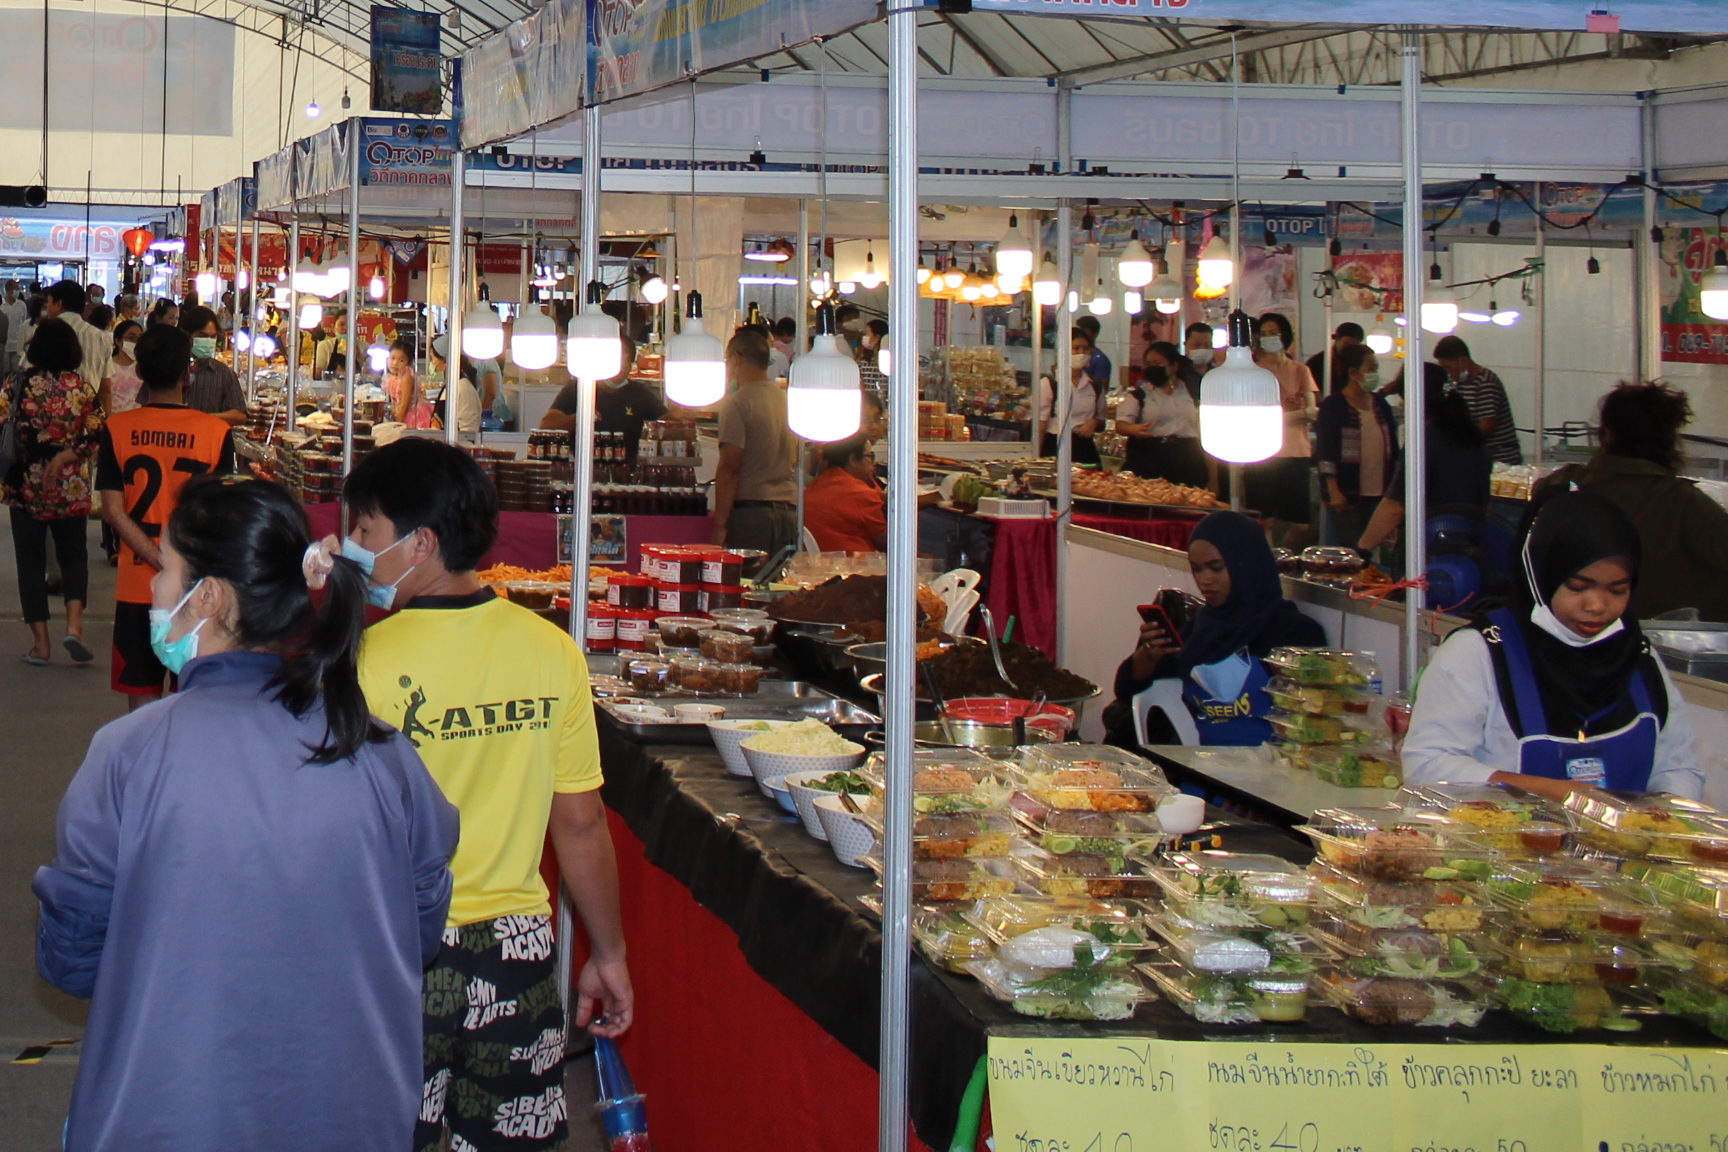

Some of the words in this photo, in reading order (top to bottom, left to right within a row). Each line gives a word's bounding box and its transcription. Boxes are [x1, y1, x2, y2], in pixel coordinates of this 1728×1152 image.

[366, 141, 435, 166] OTOP
[1266, 219, 1314, 234] OTOP
[441, 728, 493, 740] SPORTS
[497, 723, 523, 734] DAY
[1531, 1065, 1578, 1090] ยะลา
